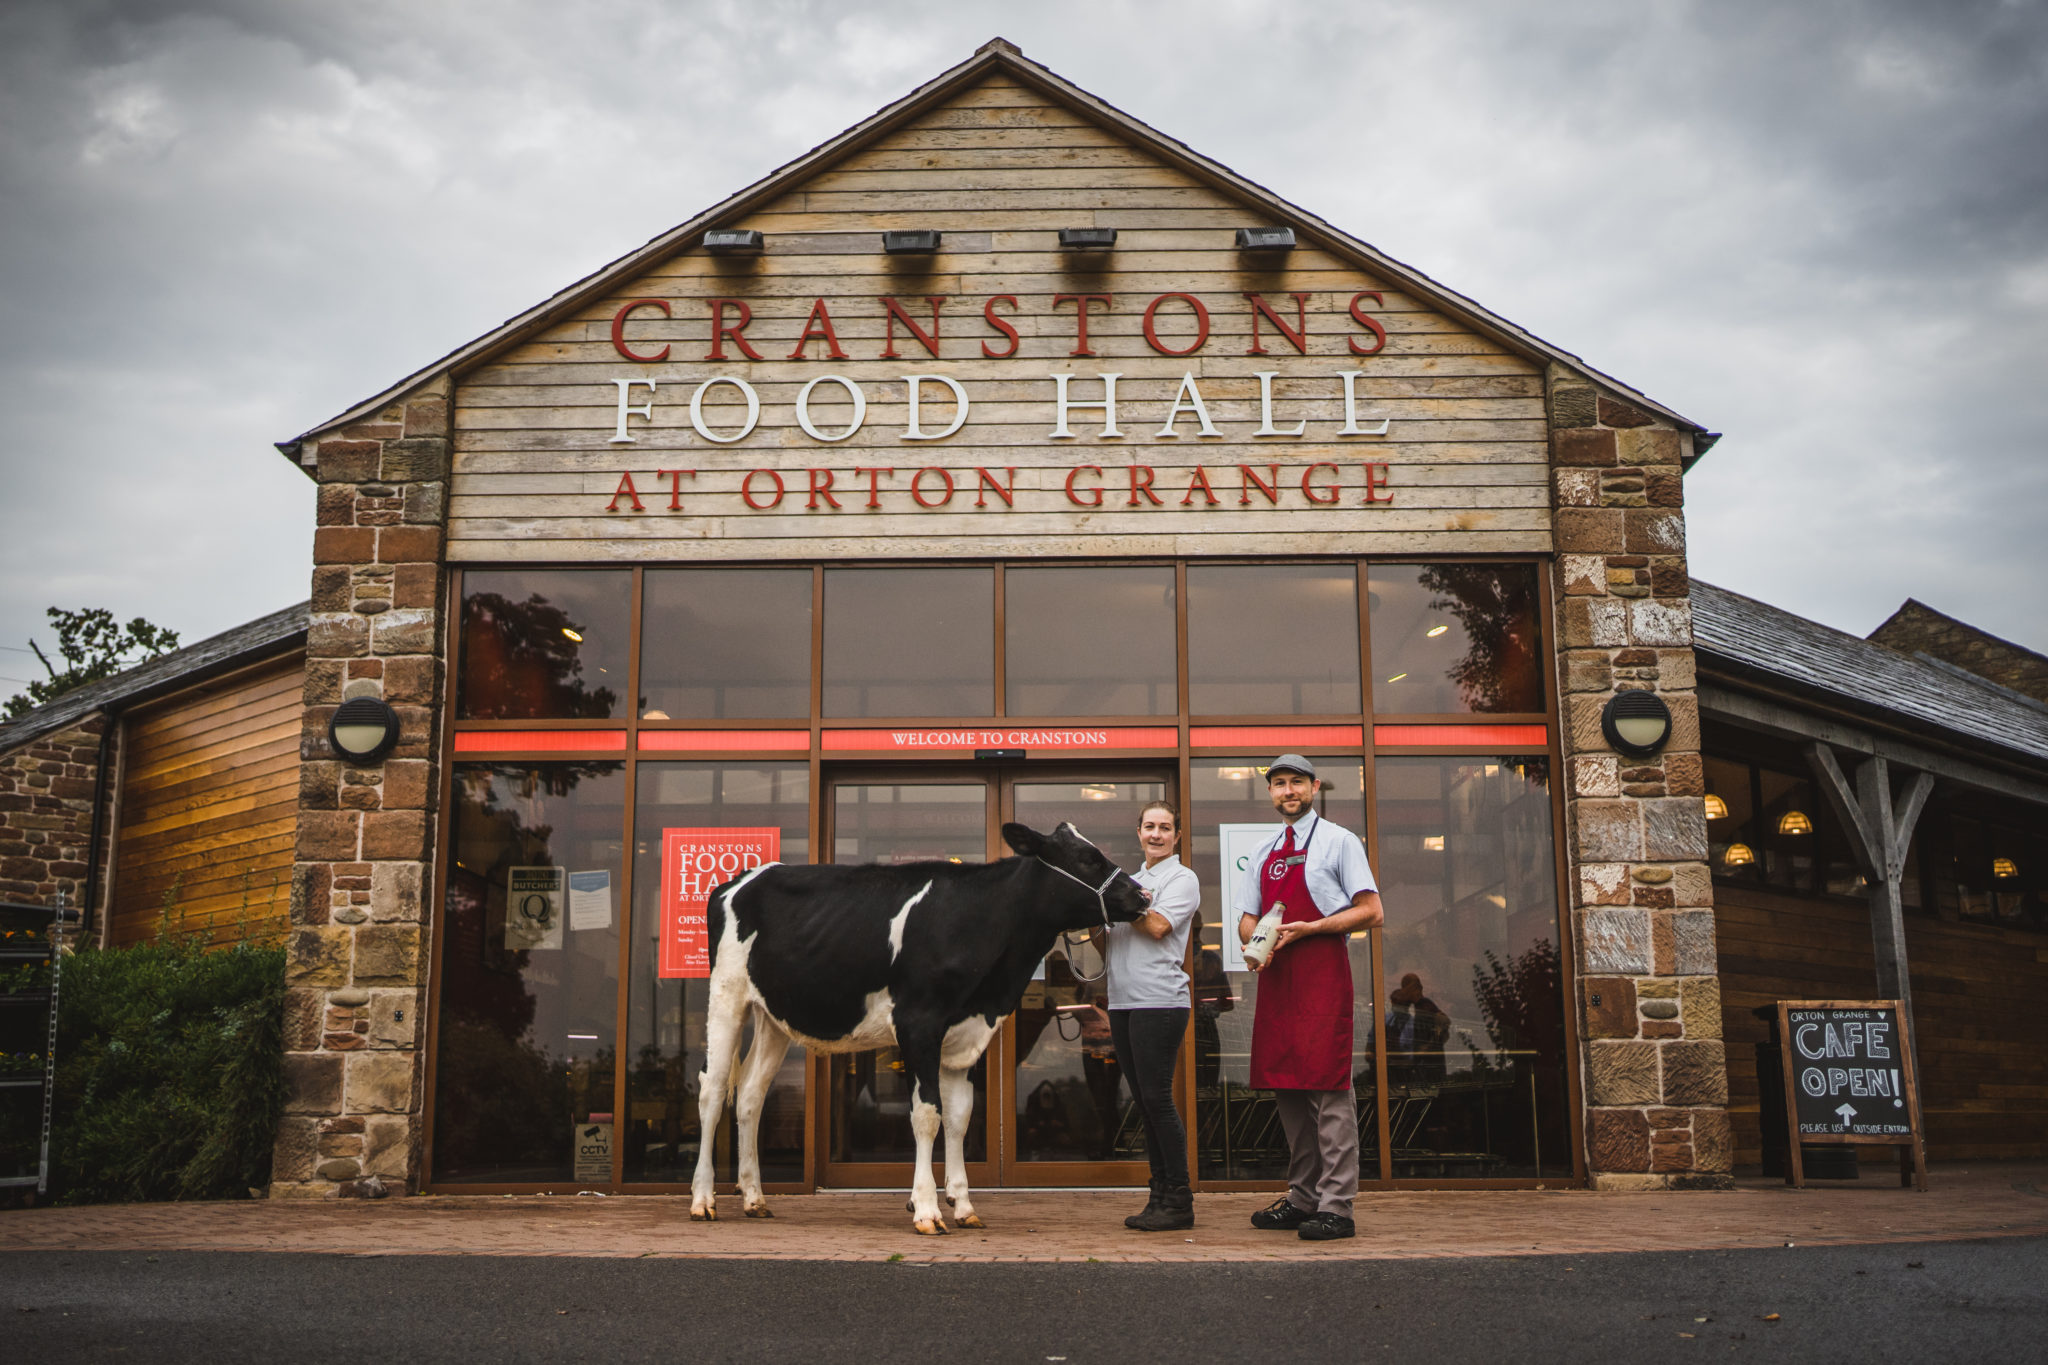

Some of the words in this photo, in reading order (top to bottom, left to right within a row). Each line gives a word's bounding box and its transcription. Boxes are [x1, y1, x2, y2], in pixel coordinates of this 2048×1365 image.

[610, 291, 1387, 362] CRANSTONS
[608, 374, 970, 443] FOOD
[1048, 370, 1391, 438] HALL
[605, 469, 697, 511] AT
[741, 466, 1018, 509] ORTON
[1064, 462, 1395, 506] GRANGE
[892, 732, 976, 745] WELCOME
[979, 732, 1003, 745] TO
[1007, 731, 1107, 745] CRANSTONS
[680, 844, 762, 853] CRANSTONS
[680, 852, 762, 873] FOOD
[1274, 863, 1283, 875] C
[521, 894, 551, 923] Q
[1790, 1011, 1825, 1022] ORTON
[1832, 1010, 1871, 1019] GRANGE
[1795, 1022, 1890, 1060] CAFE
[1801, 1067, 1903, 1108] OPEN!
[1800, 1123, 1829, 1133] PLEASE
[1832, 1123, 1846, 1133] USE
[1853, 1123, 1881, 1134] OUTSIDE
[581, 1145, 608, 1154] CCTV
